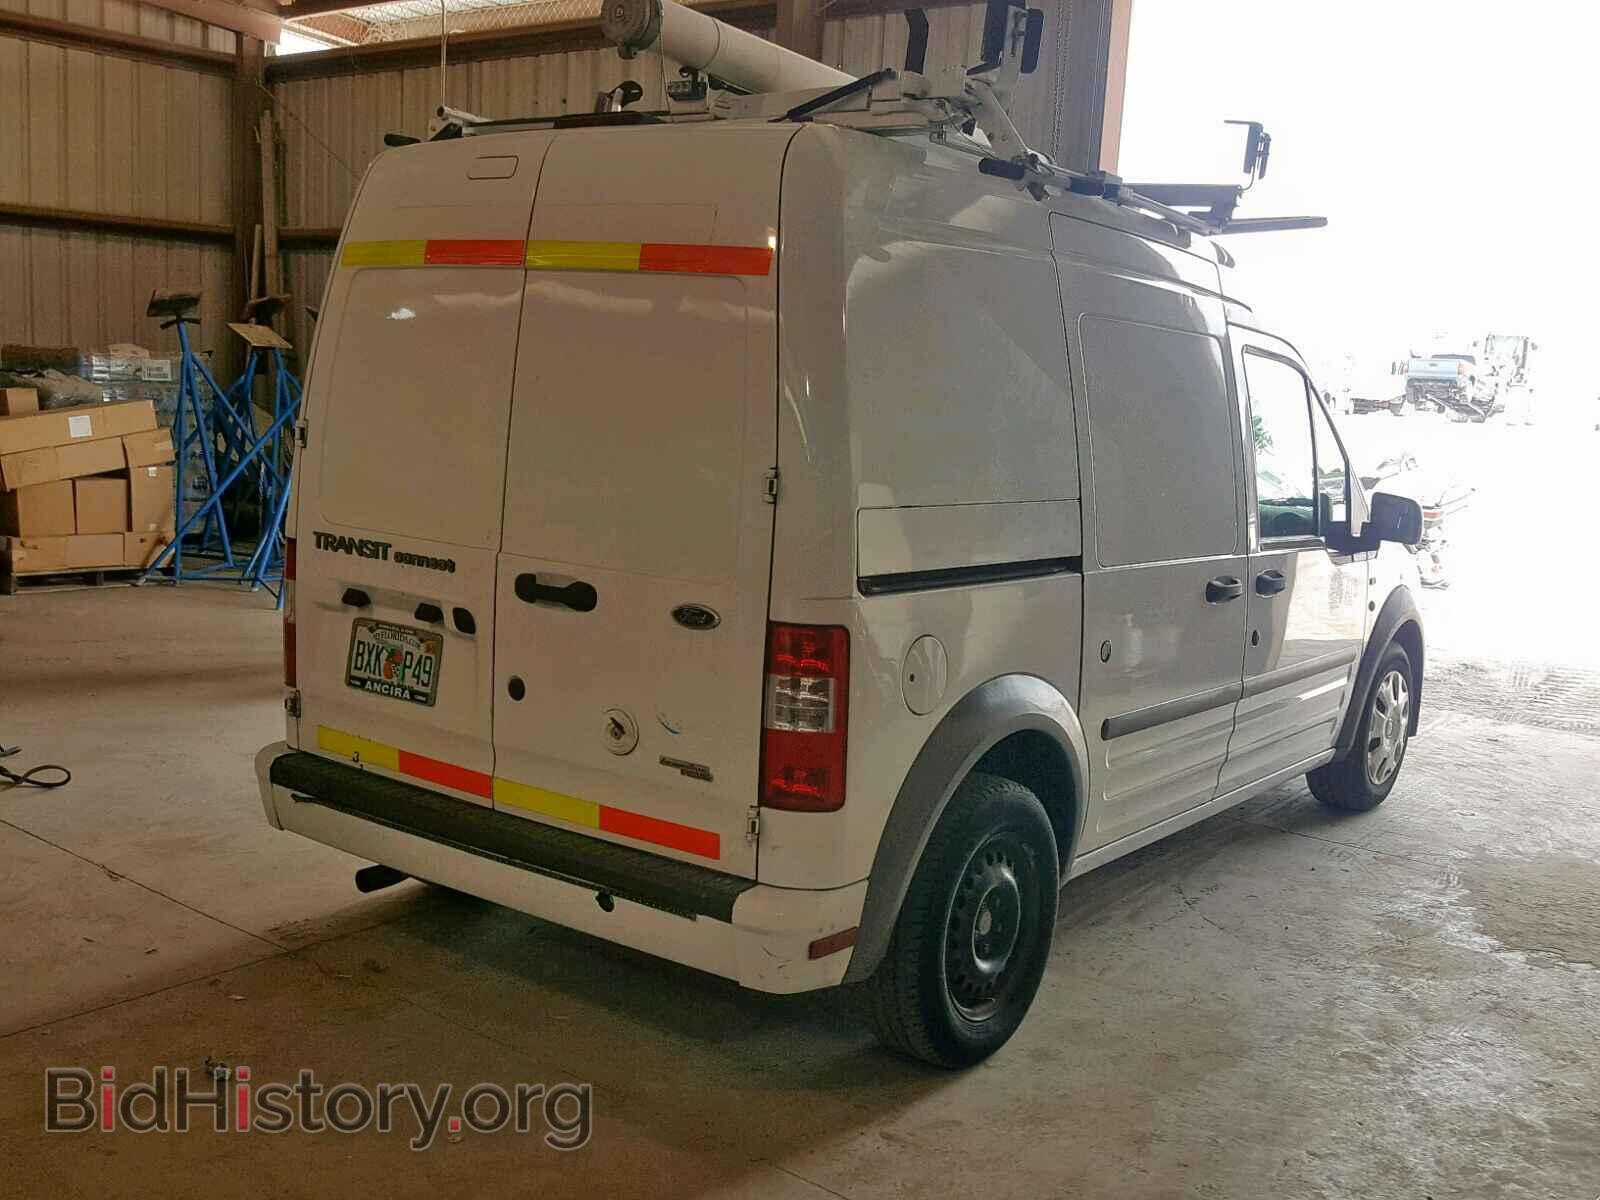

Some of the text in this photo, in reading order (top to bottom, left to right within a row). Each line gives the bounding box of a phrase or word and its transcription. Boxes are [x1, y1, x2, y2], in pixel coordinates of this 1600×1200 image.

[313, 531, 456, 574] TRANSIT connect
[353, 640, 433, 688] BXK P49
[364, 680, 412, 700] ANCIRA
